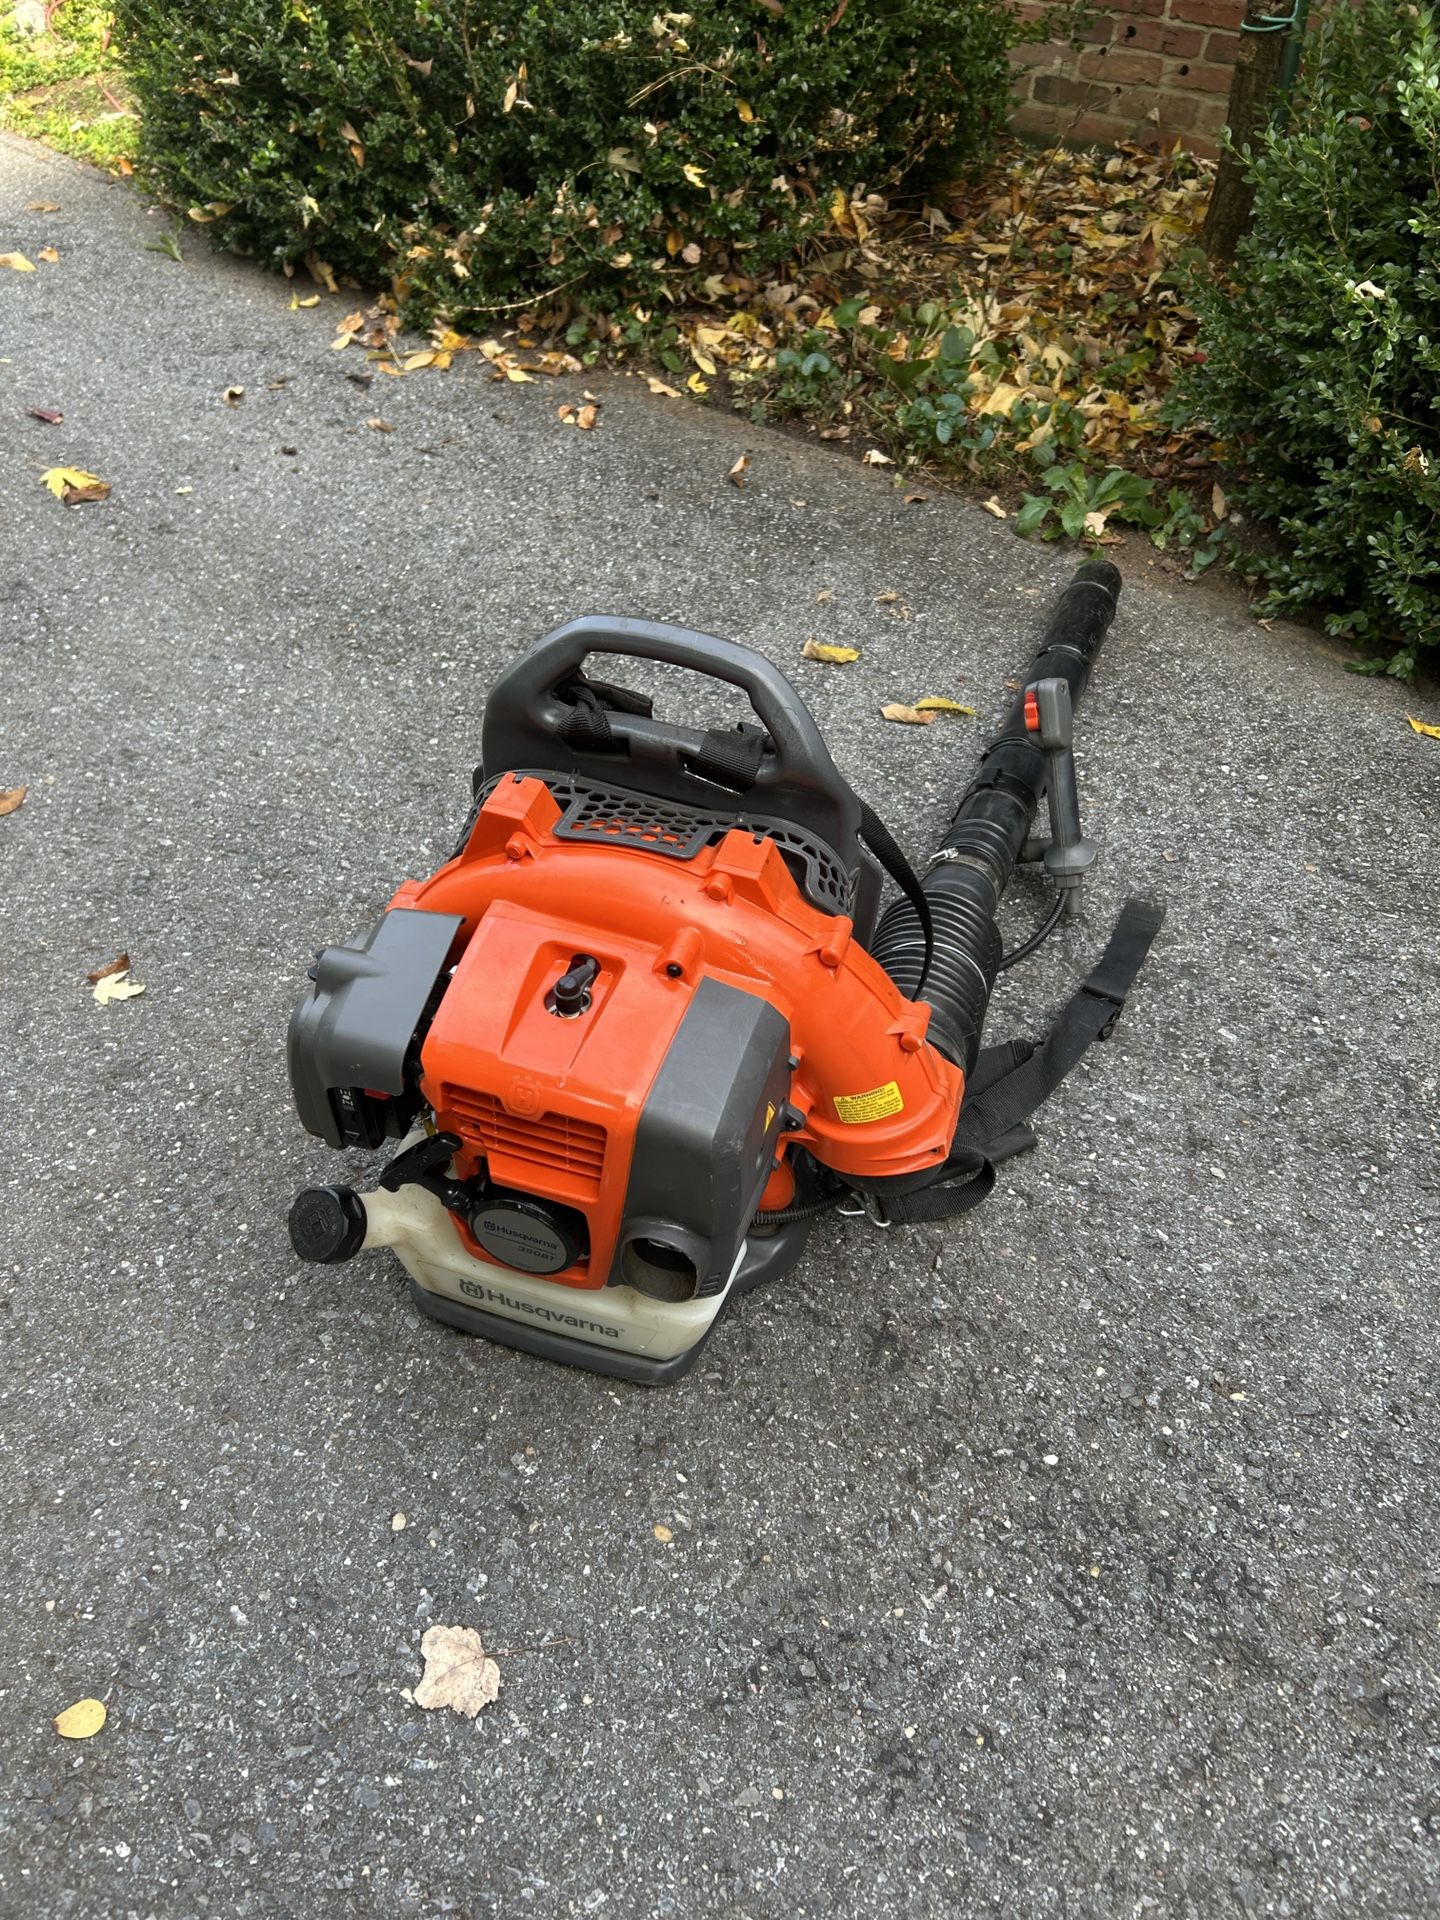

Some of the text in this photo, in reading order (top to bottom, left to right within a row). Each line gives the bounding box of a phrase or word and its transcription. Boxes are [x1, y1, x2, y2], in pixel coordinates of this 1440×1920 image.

[850, 1087, 885, 1101] WARNING!
[496, 1224, 557, 1249] Husqvarna
[517, 1245, 556, 1261] 350BT
[488, 1288, 619, 1338] Husqvarna
